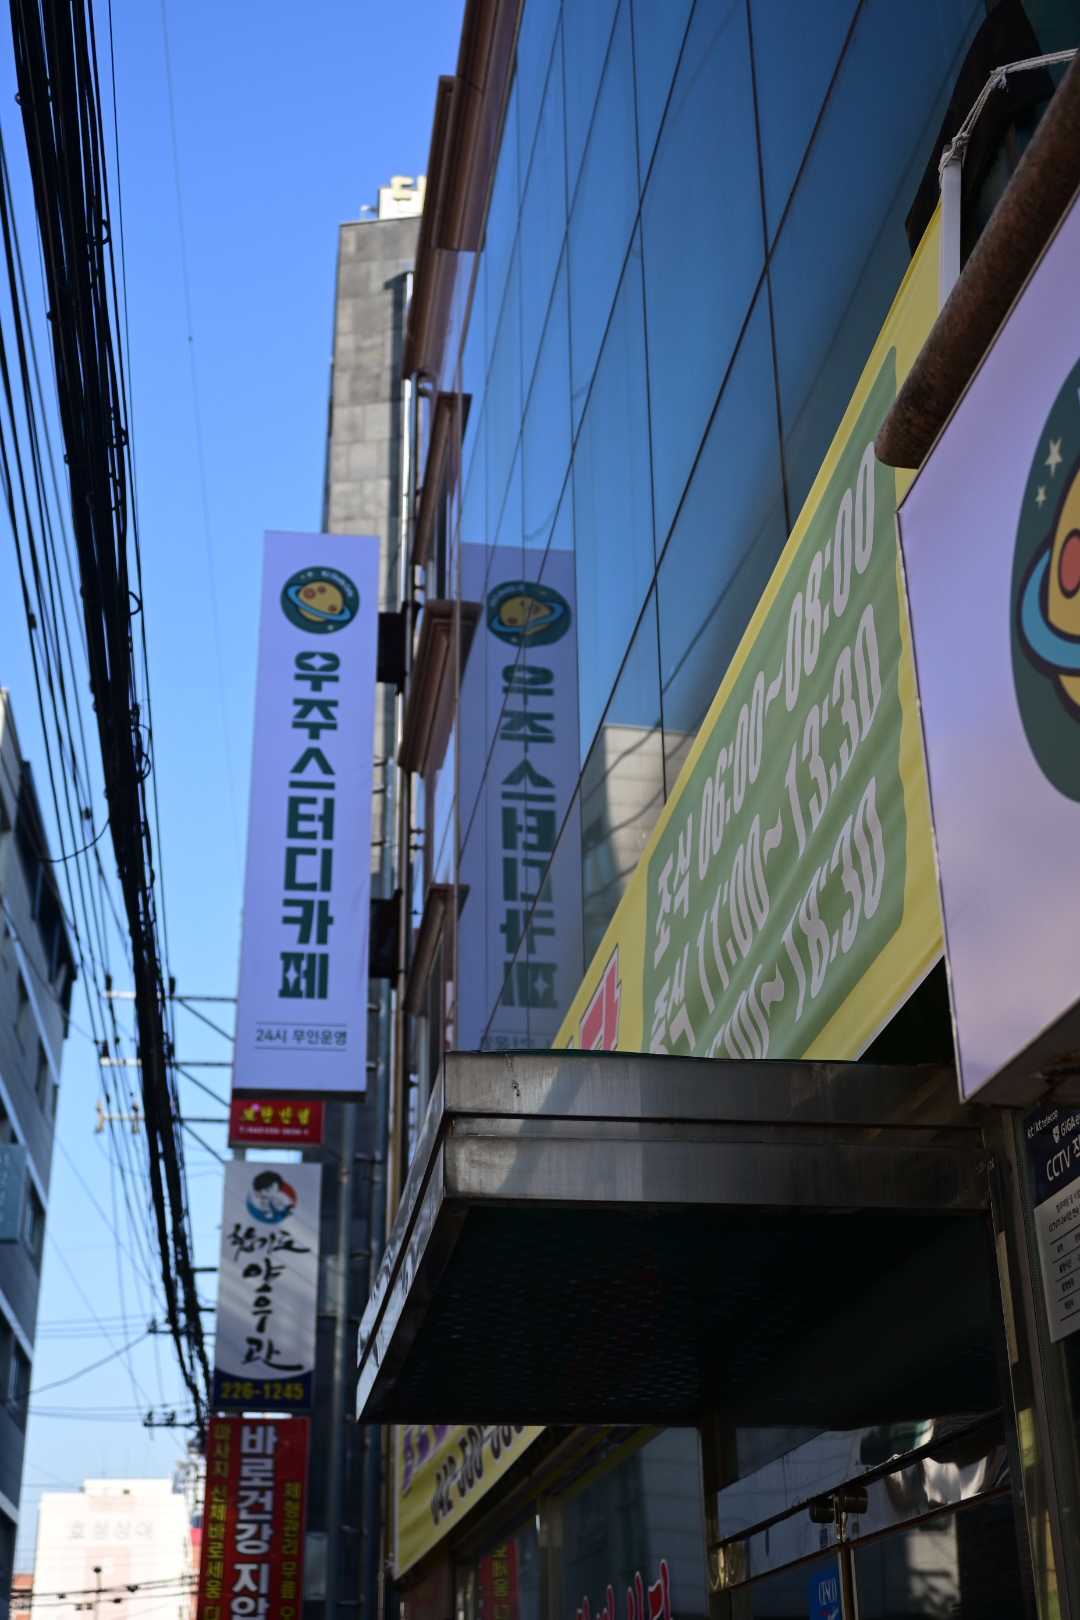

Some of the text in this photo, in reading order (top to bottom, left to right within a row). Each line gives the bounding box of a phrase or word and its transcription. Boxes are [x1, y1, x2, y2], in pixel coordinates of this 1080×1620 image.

[277, 650, 342, 1000] 우주스터디카페
[654, 812, 693, 971] 조식
[255, 1028, 347, 1046] 24시 무인운영
[1046, 1145, 1070, 1181] CCTV
[221, 1381, 305, 1400] 226-1245
[233, 1424, 279, 1556] 바로건강
